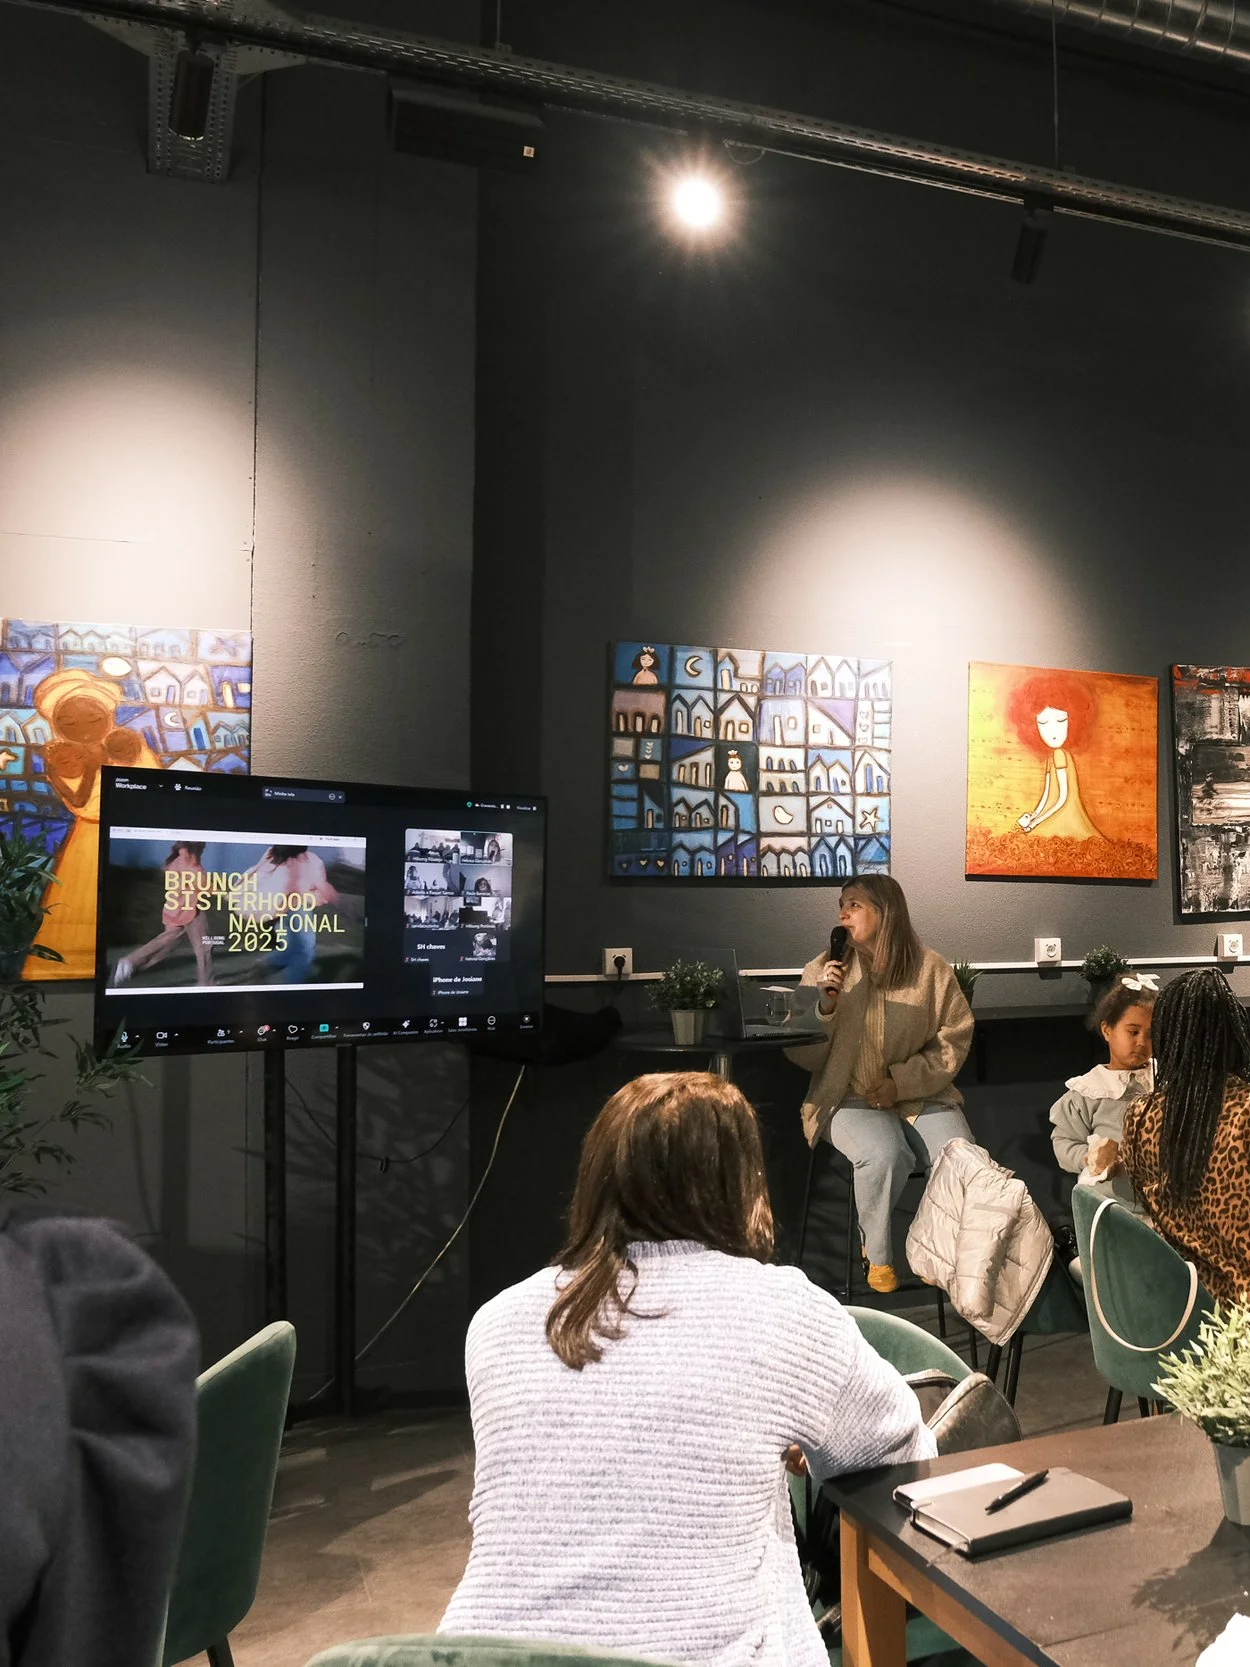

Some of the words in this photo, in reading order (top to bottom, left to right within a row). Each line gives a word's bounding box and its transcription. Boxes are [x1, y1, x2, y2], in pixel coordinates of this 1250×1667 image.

[164, 870, 258, 892] BRUNCH
[164, 890, 316, 912] SISTERHOOD
[229, 914, 346, 932] NACIONAL
[228, 932, 288, 952] 2025
